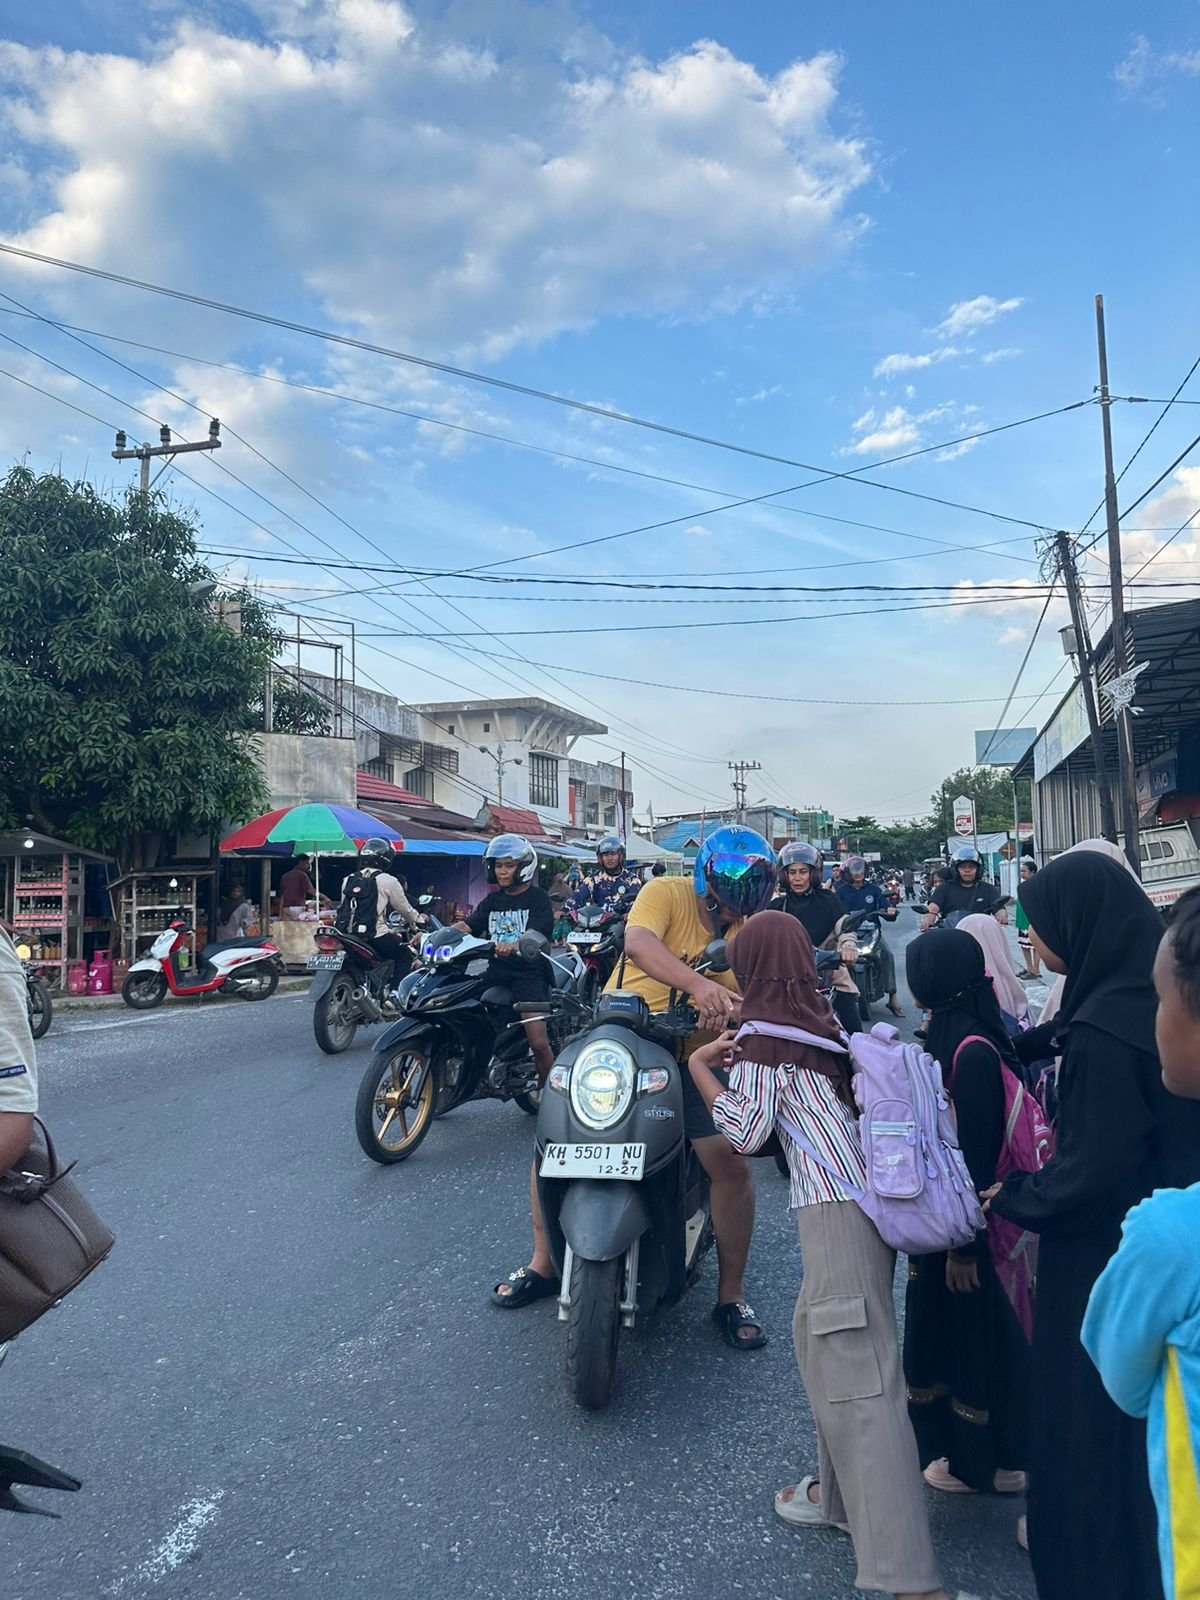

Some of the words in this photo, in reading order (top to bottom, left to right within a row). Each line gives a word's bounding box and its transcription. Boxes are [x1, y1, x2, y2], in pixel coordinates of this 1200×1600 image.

[547, 1145, 567, 1159] KH
[574, 1146, 611, 1160] 5501
[622, 1145, 642, 1159] NU
